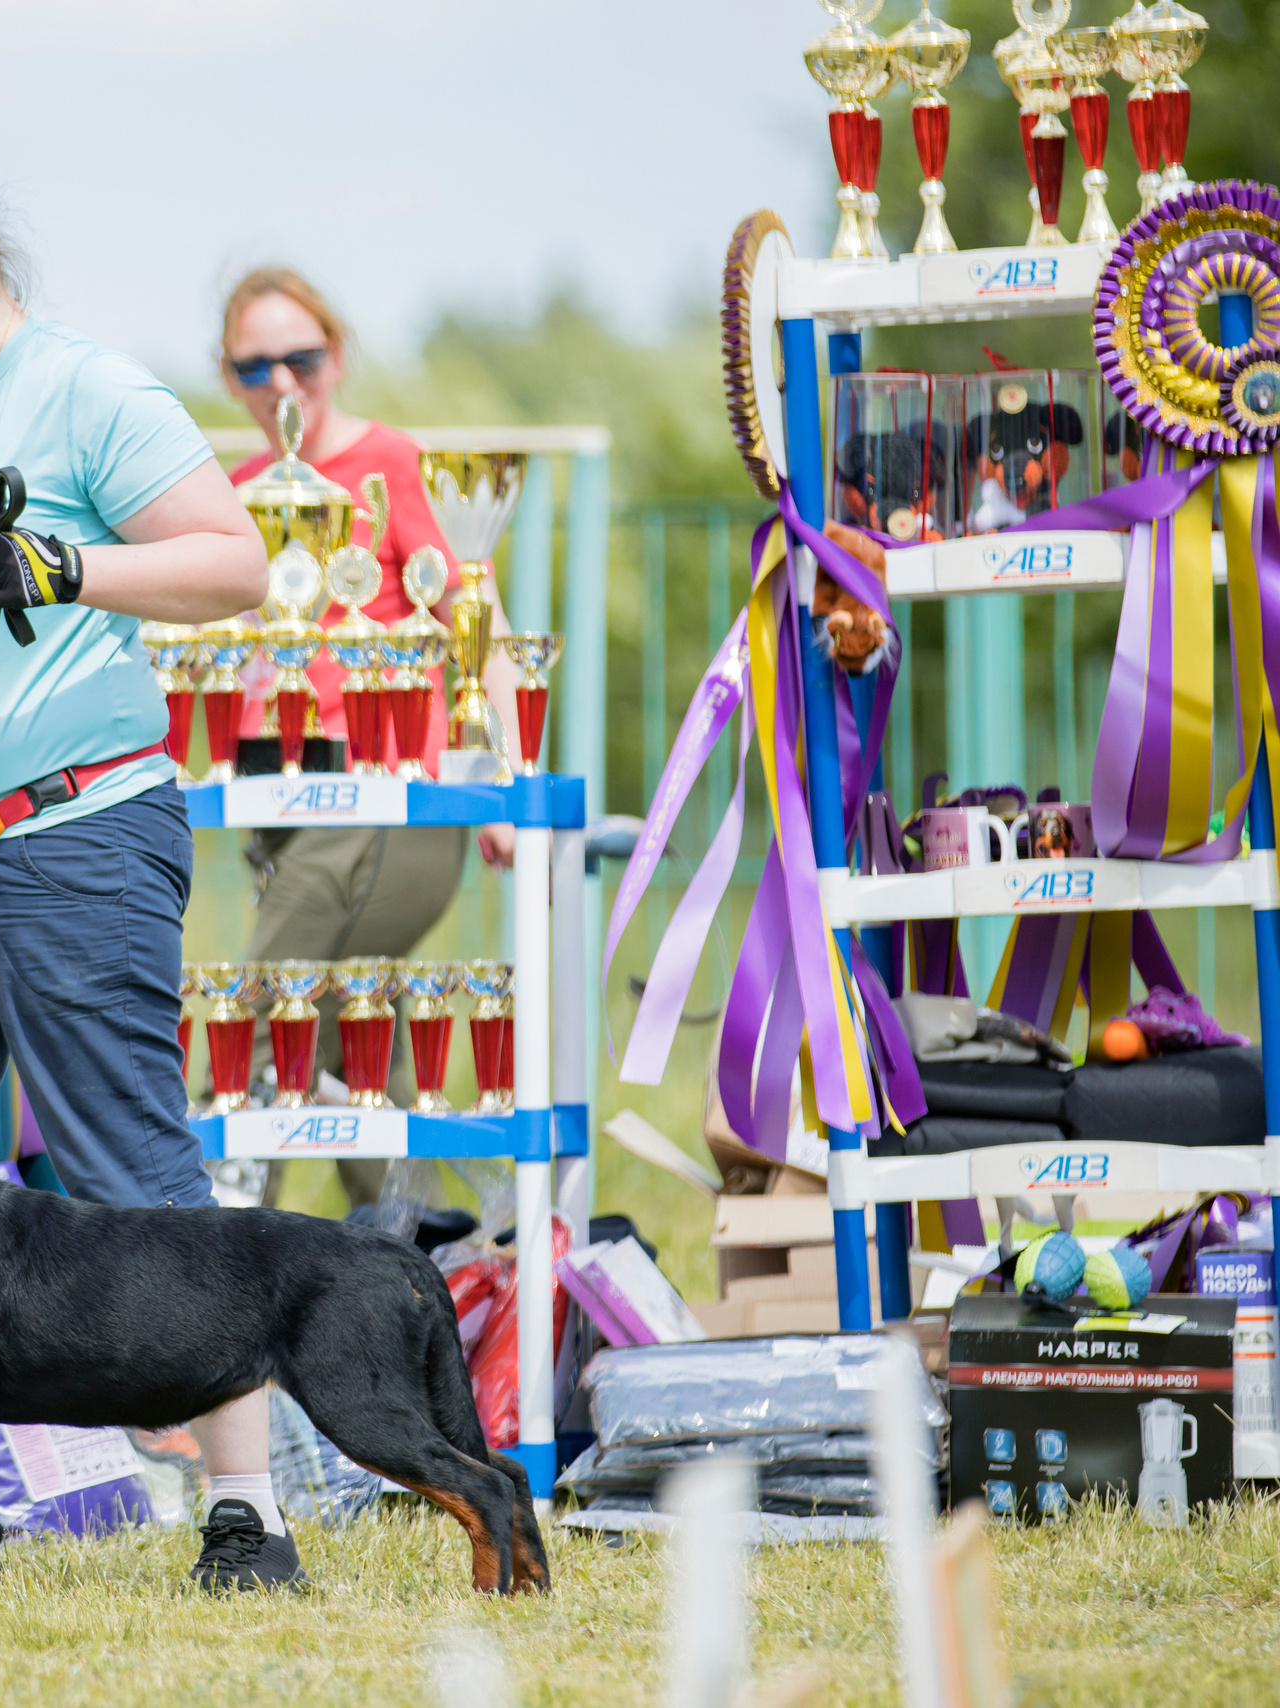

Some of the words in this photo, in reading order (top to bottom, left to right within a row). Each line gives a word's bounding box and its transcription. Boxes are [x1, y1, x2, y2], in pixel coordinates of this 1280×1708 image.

[11, 539, 25, 558] BIKE
[21, 558, 43, 602] CONCEPT
[1202, 1263, 1258, 1281] НАБОР
[1202, 1277, 1273, 1295] ПОСУДЫ
[1037, 1341, 1141, 1360] HARPER
[981, 1370, 1043, 1387] БЛЕНДЕР
[1045, 1371, 1135, 1387] НАСТОЛЬНЫЙ
